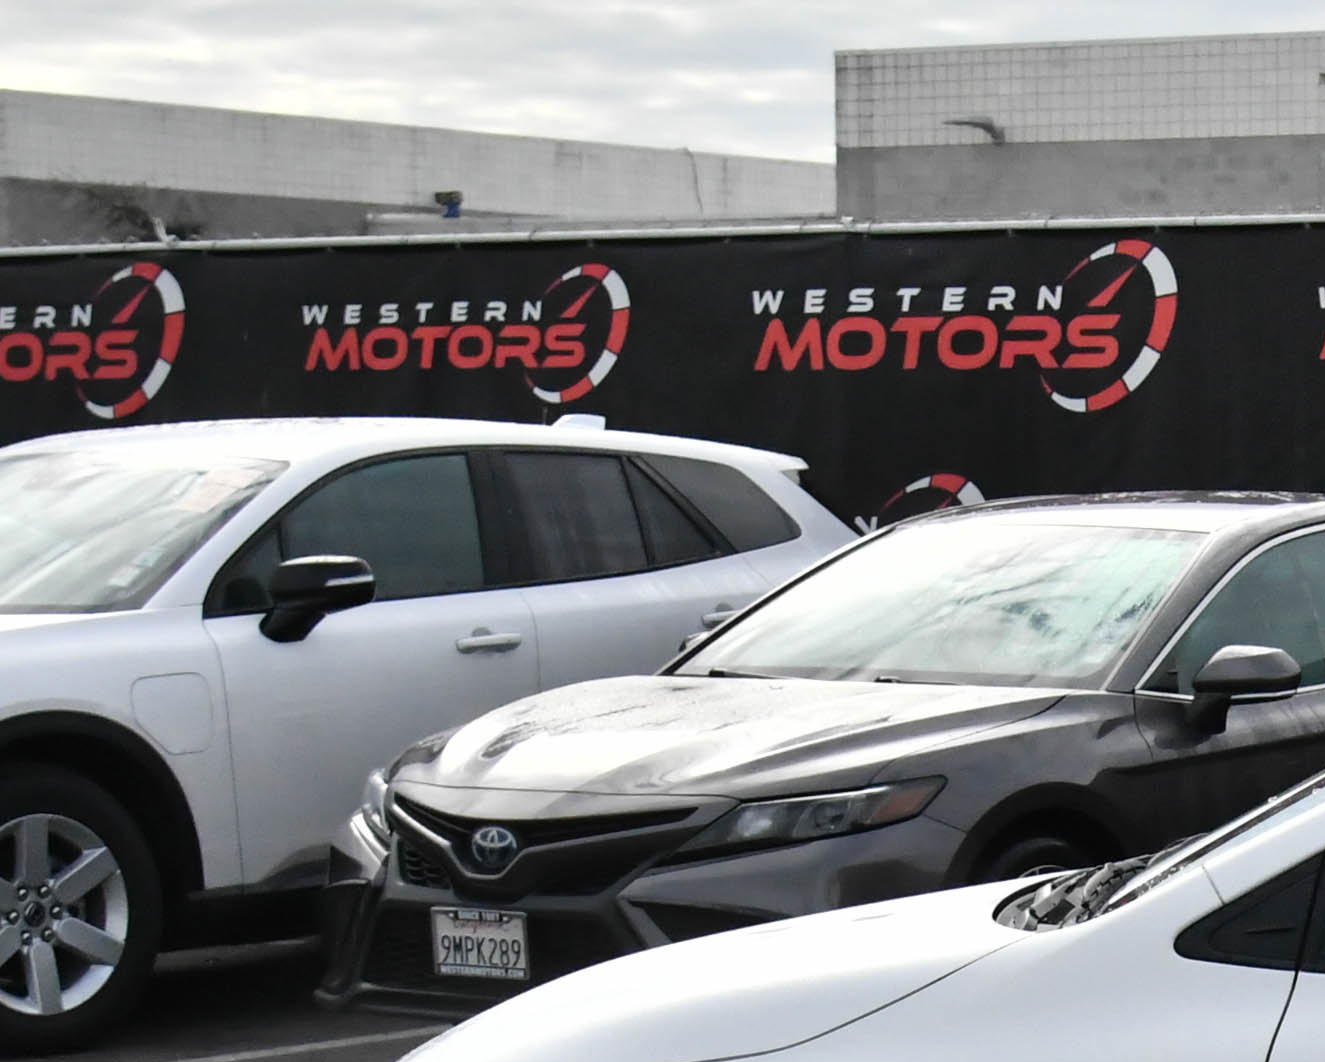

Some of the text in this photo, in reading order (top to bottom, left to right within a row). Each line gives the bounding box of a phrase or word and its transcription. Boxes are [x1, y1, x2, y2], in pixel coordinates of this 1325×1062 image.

[302, 300, 542, 326] WESTERN
[752, 285, 1063, 315] WESTERN
[305, 323, 586, 372] MOTORS
[754, 314, 1121, 371] MOTORS
[441, 934, 522, 968] 9MPK289
